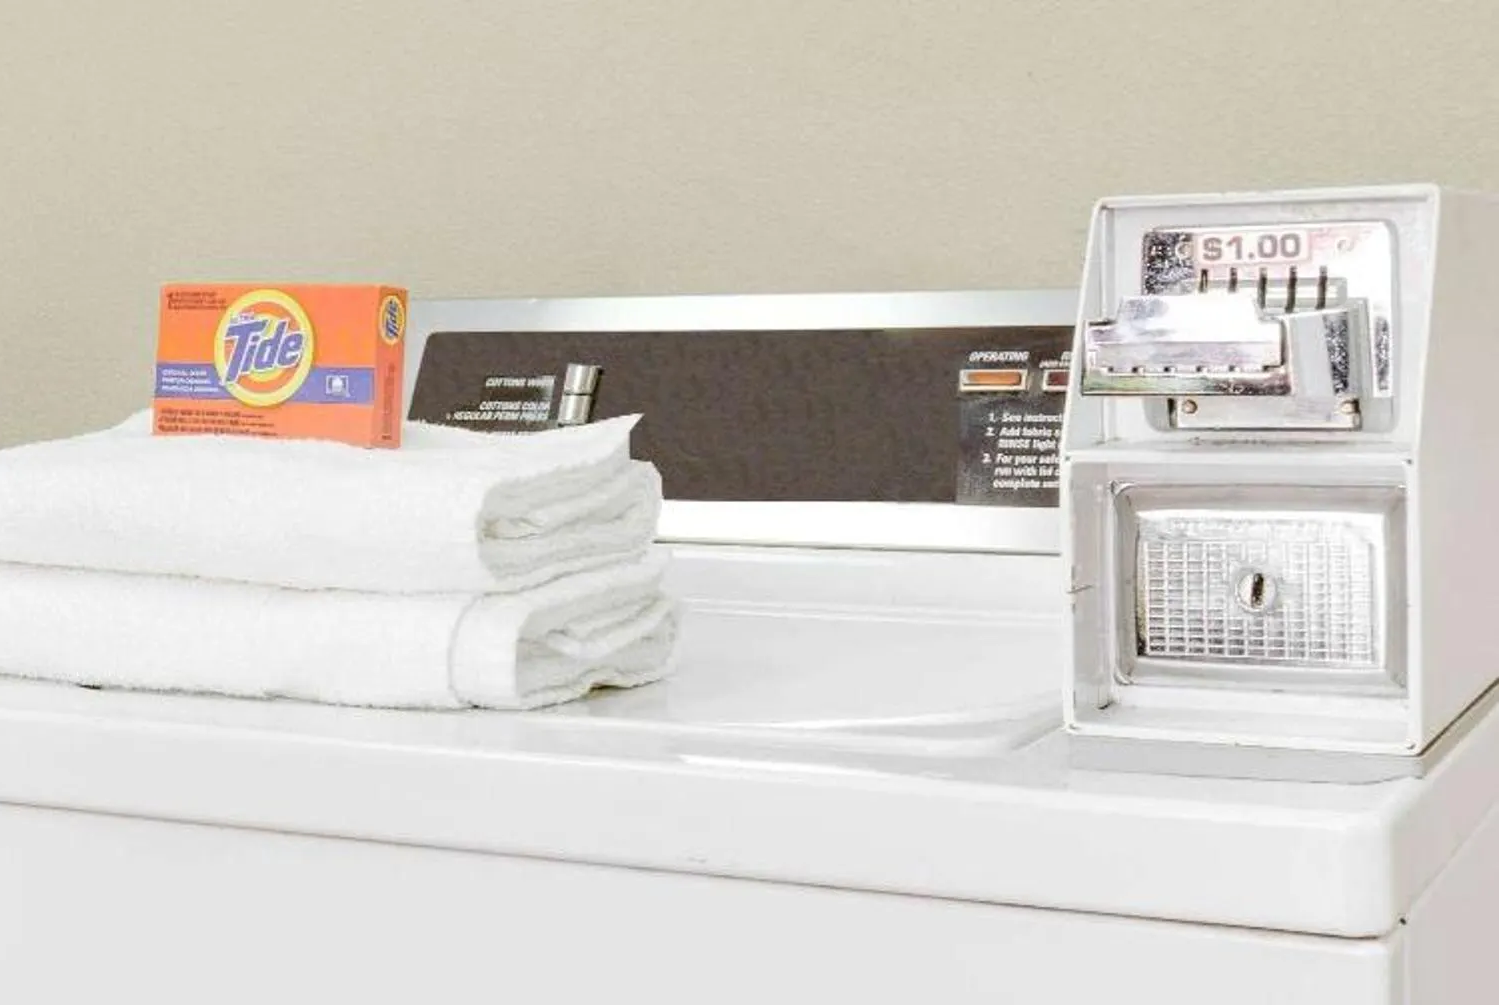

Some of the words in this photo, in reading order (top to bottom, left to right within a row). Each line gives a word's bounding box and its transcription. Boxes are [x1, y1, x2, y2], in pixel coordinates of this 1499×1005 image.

[1201, 232, 1301, 261] $1.00
[384, 299, 400, 340] Tide
[221, 317, 305, 386] Tide
[969, 351, 1029, 361] OPERATING
[1023, 412, 1062, 422] instruct
[999, 427, 1020, 436] Add
[996, 453, 1012, 463] For
[1014, 455, 1037, 465] your
[1013, 465, 1037, 476] with
